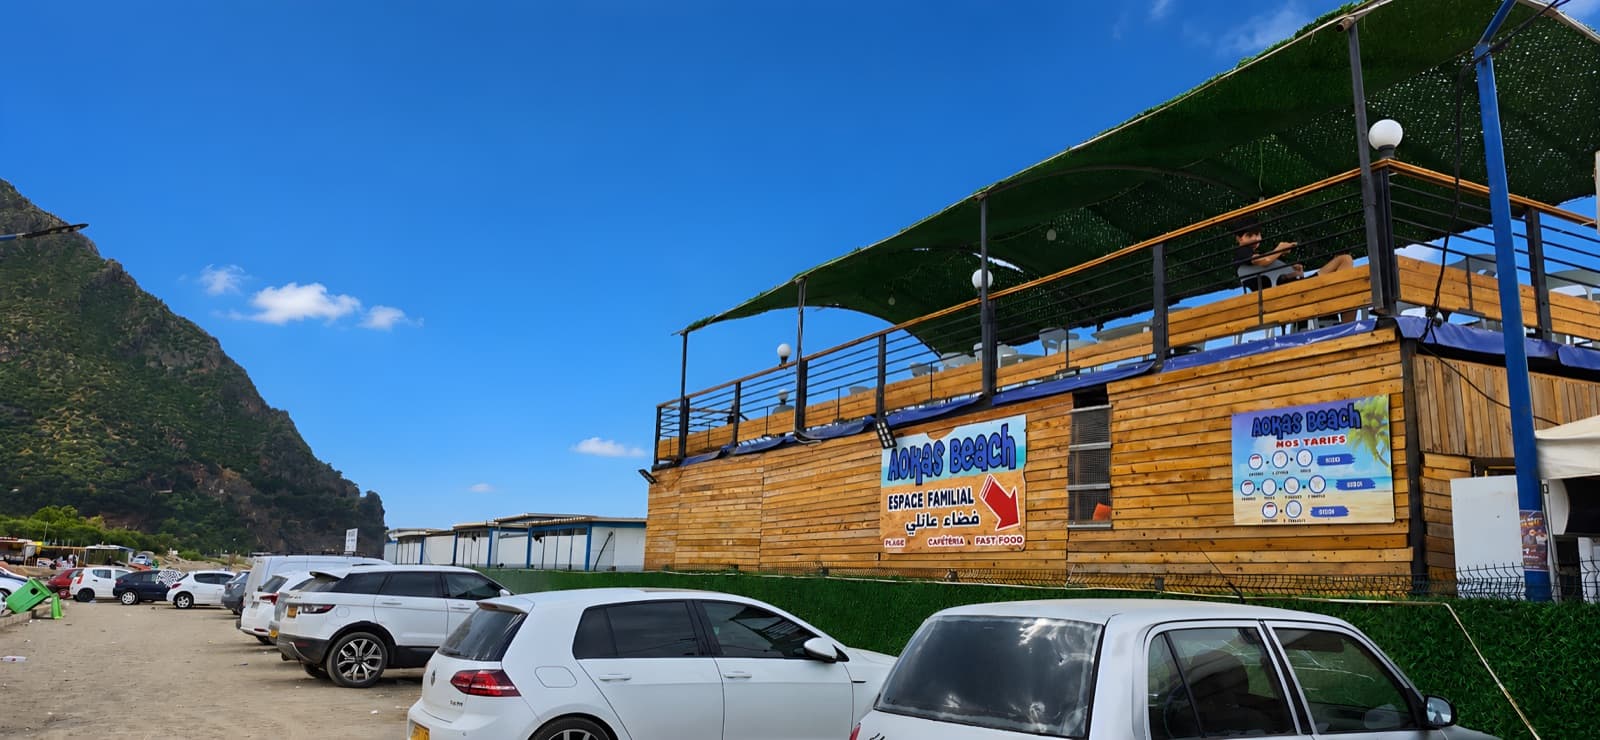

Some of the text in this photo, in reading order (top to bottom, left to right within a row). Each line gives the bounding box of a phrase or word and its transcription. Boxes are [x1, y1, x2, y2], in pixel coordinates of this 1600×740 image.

[1276, 435, 1347, 448] NOS TARIFS
[888, 487, 974, 510] ESPACE FAMILIAL
[943, 510, 980, 527] فضاء
[975, 536, 1024, 545] FAST FOOD
